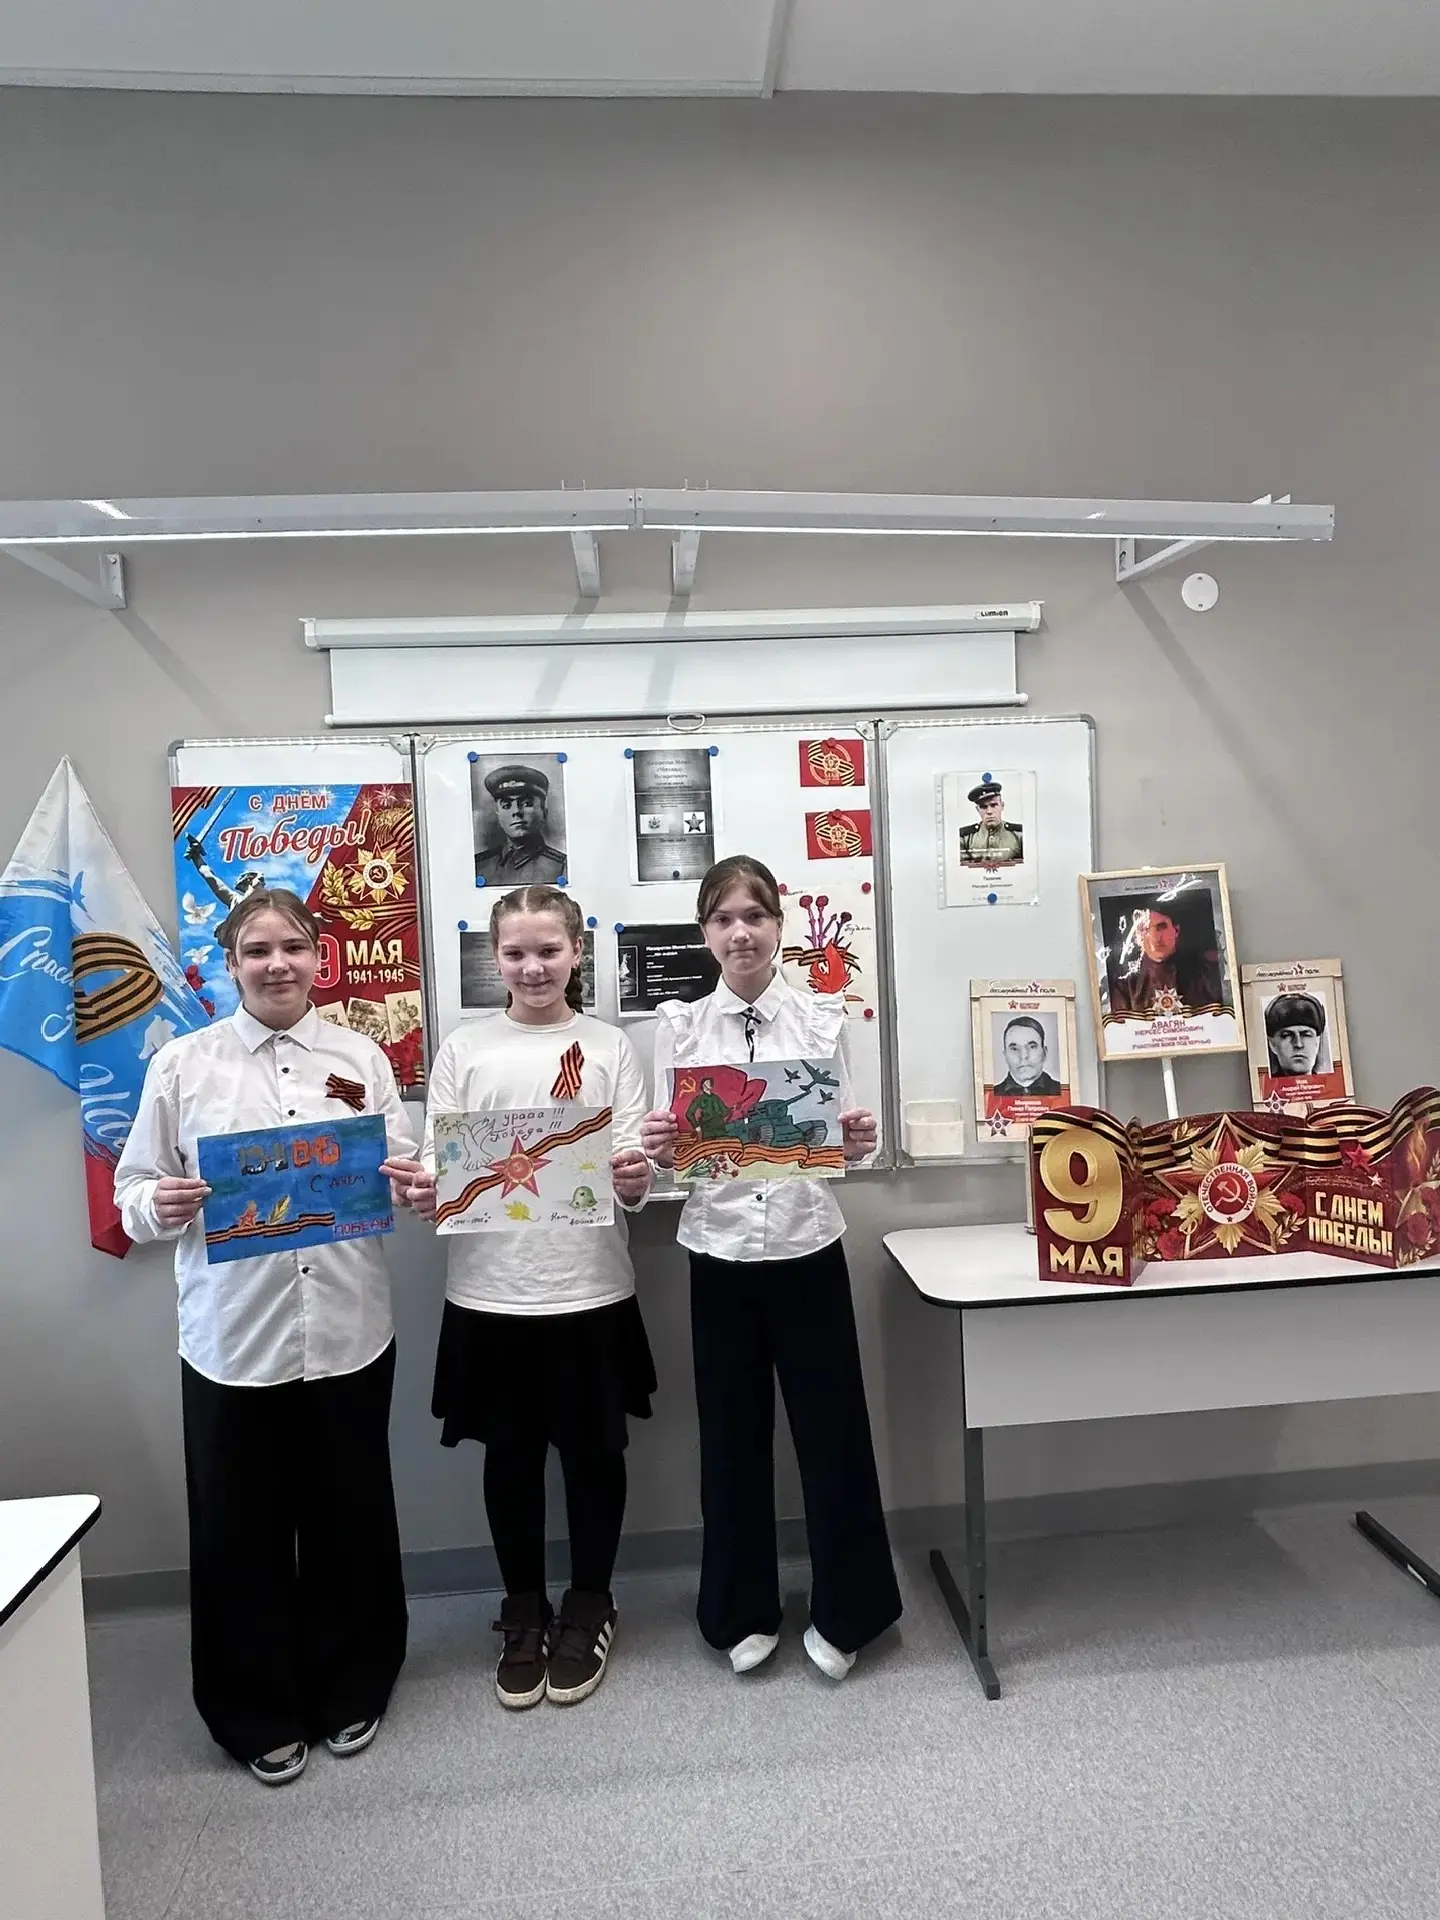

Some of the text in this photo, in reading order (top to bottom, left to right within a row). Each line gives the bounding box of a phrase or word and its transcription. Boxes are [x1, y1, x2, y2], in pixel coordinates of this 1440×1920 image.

[250, 790, 328, 812] С ДНЁМ
[220, 808, 373, 865] Победы!
[312, 933, 403, 989] 9 МАЯ
[346, 969, 405, 984] 1941-1945
[1151, 1019, 1186, 1029] АВАГЯН
[1039, 1129, 1123, 1243] 9
[1201, 1165, 1250, 1213] ОТЕЧЕСТВЕННАЯ
[1315, 1191, 1384, 1228] С ДНЕМ
[1308, 1216, 1394, 1258] ПОБЕДЫ!
[1049, 1243, 1125, 1277] МАЯ
